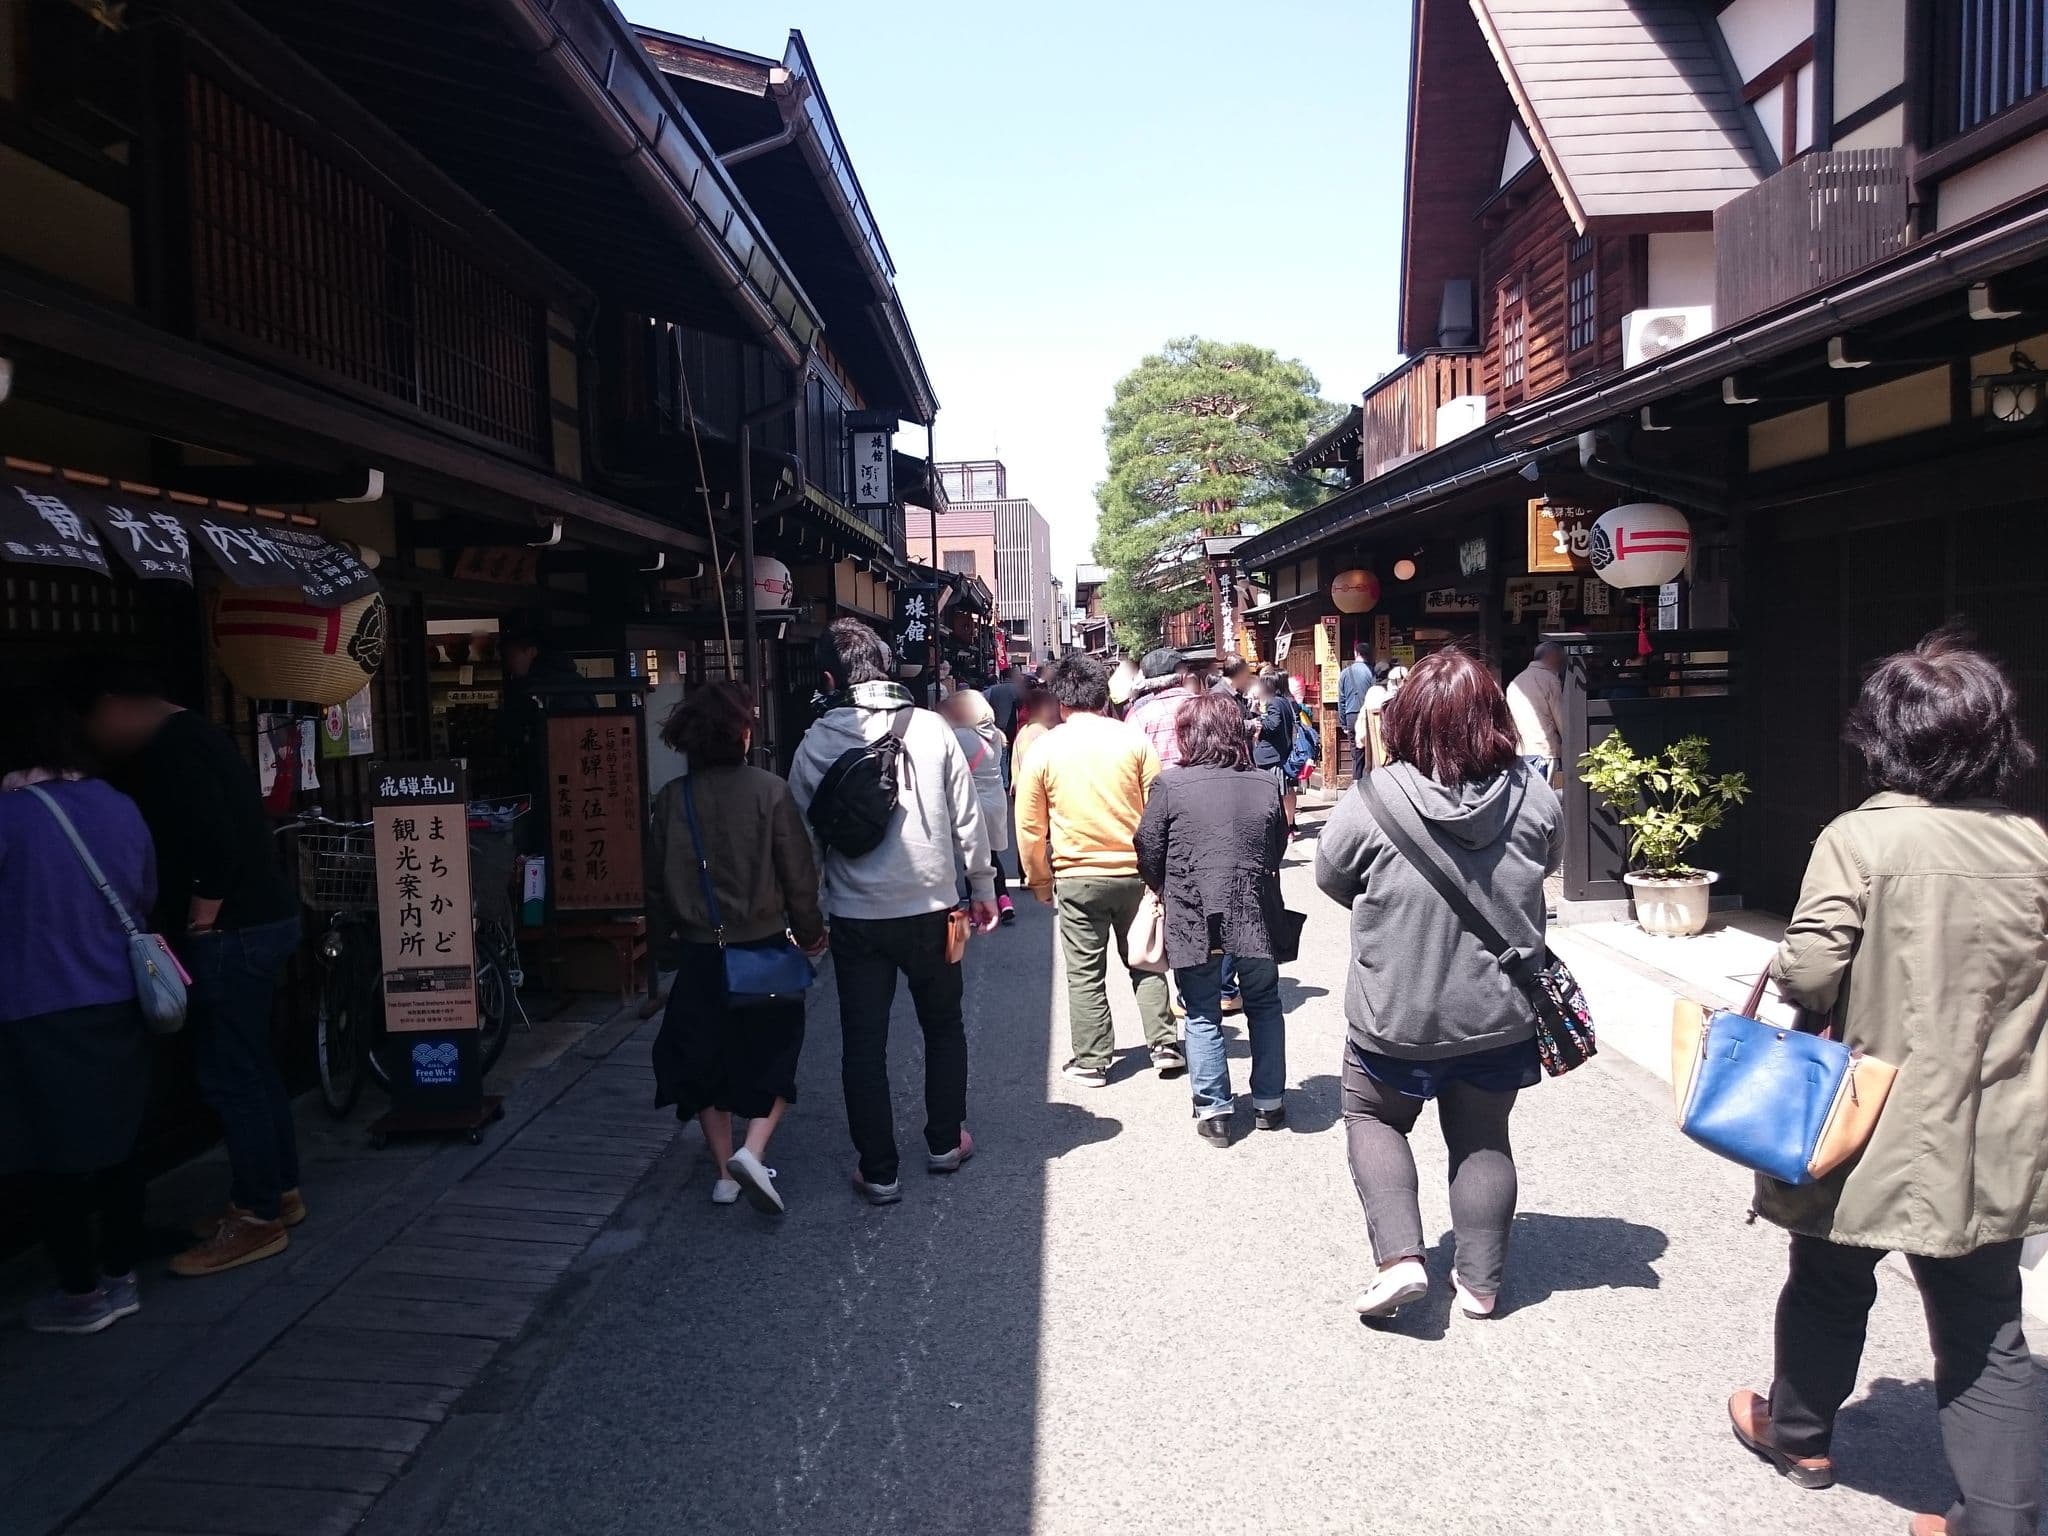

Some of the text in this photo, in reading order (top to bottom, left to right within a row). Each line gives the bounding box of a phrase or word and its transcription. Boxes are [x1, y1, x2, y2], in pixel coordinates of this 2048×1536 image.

[871, 434, 885, 462] 旅館
[905, 593, 929, 642] 旅館
[380, 776, 455, 796] 飛騨高山
[392, 817, 426, 958] 観光案内所
[428, 815, 456, 954] まちかど
[416, 1069, 456, 1077] Free Wi-Fi
